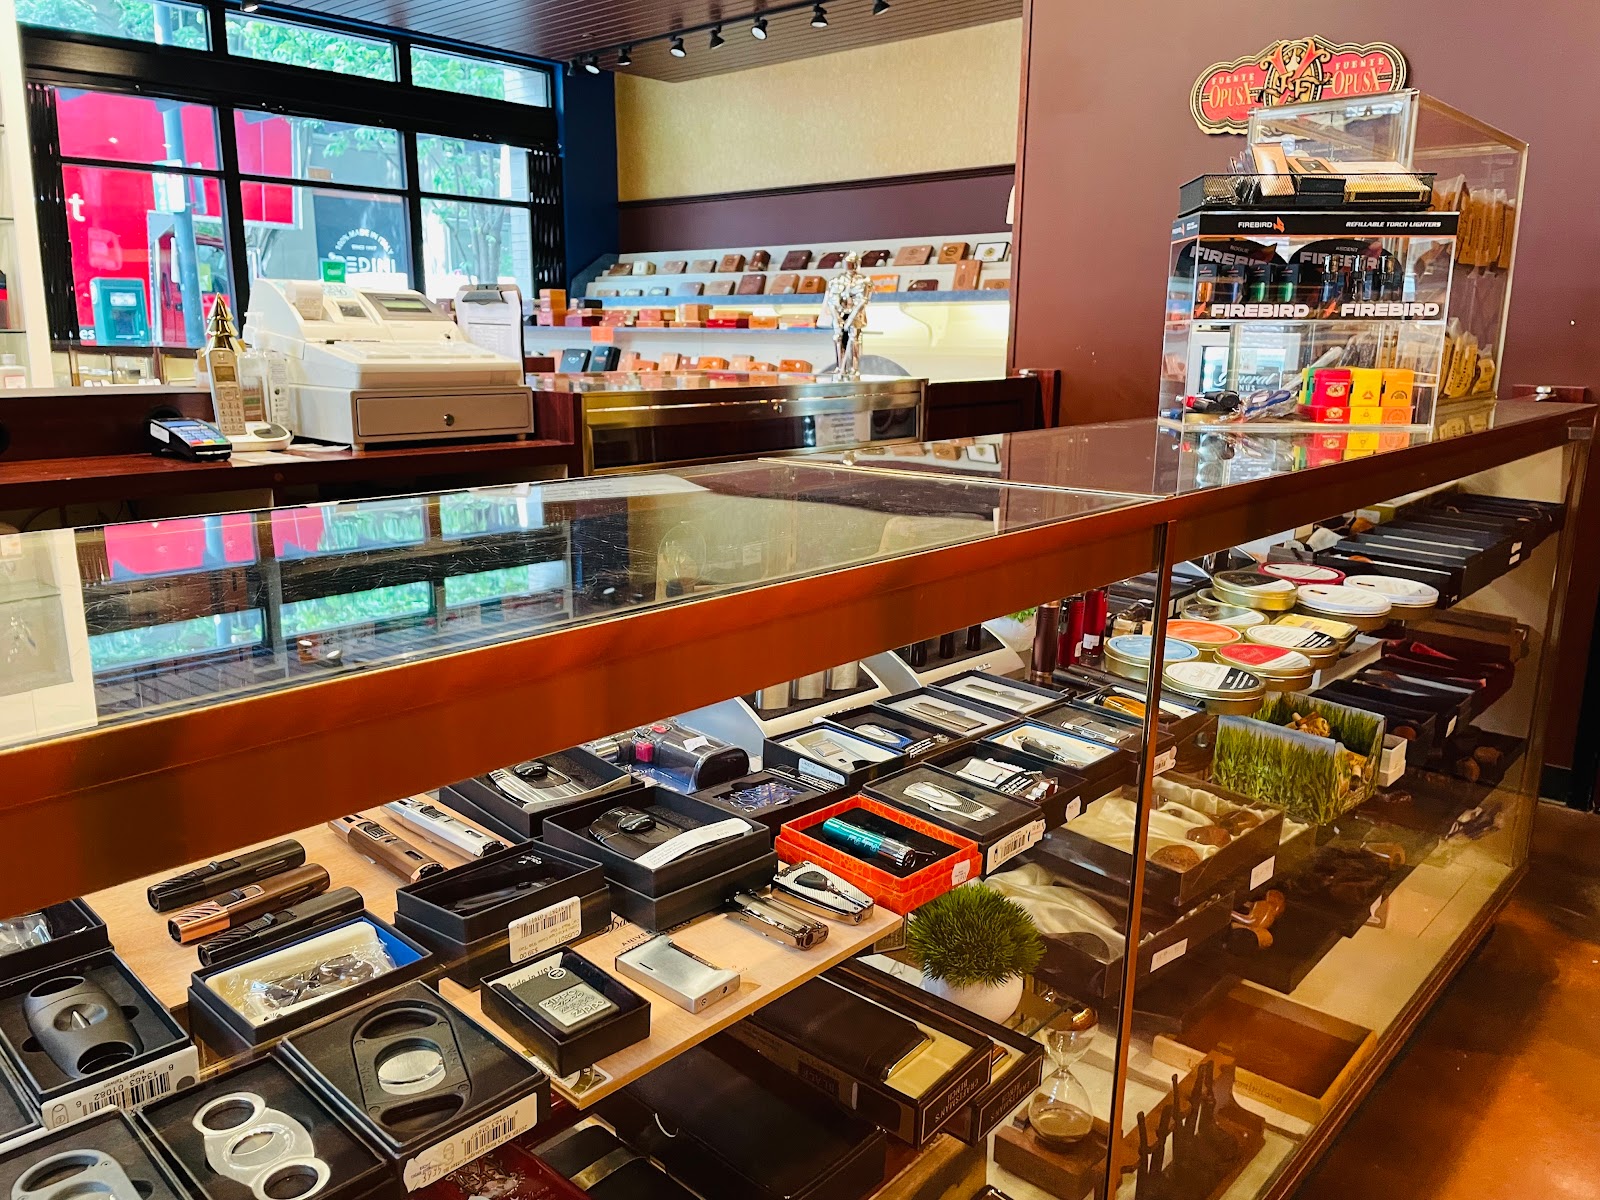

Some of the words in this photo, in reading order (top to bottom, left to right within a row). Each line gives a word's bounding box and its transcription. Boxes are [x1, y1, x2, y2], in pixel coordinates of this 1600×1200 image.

[1335, 57, 1386, 71] FUENTE
[1211, 72, 1255, 86] FUENTE
[1237, 221, 1273, 229] FIREBIRD
[1211, 303, 1310, 318] FIREBIRD
[1341, 303, 1440, 318] FIREBIRD
[129, 1068, 145, 1078] Made
[129, 1070, 158, 1087] 13463
[103, 1078, 122, 1089] Taiwan
[947, 1079, 968, 1102] BENCH
[93, 1084, 124, 1101] 01082
[491, 1115, 510, 1128] 13463
[470, 1125, 490, 1140] 01697
